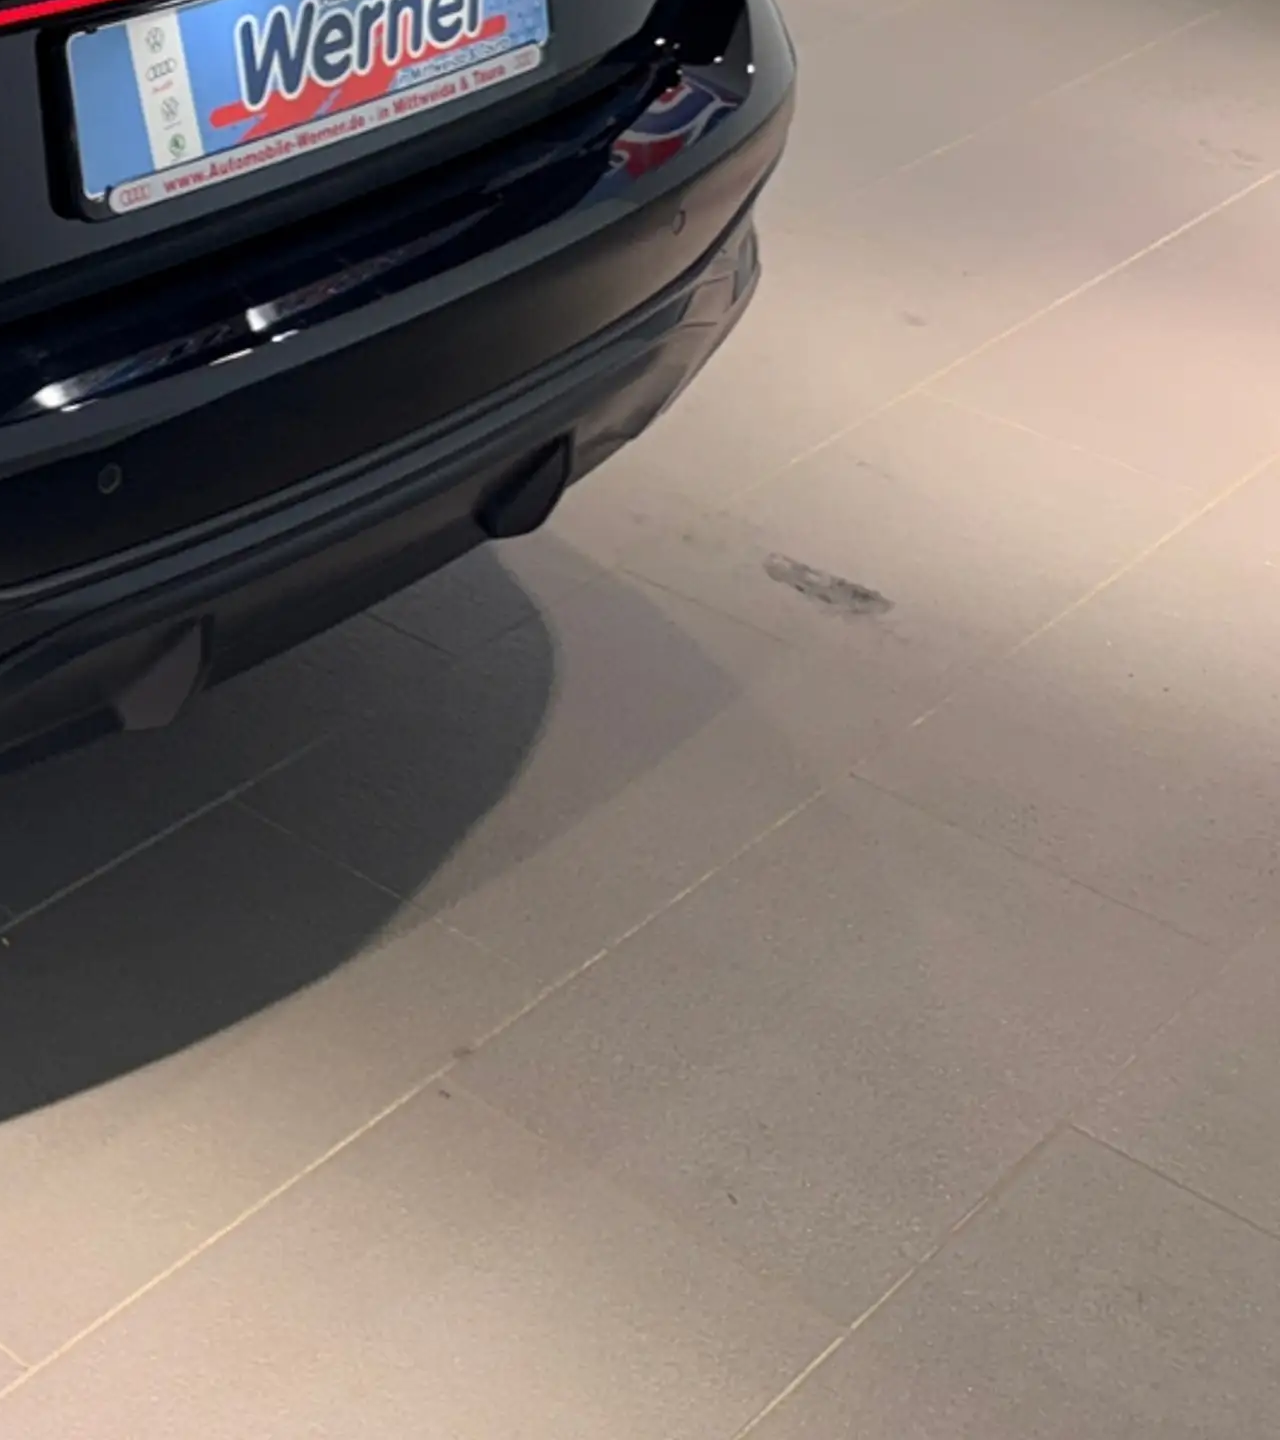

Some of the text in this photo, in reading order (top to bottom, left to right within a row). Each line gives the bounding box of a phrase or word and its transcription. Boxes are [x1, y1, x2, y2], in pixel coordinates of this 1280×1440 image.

[163, 114, 366, 193] www.Automobile-Werner.de
[392, 81, 456, 114] Mittweida
[472, 64, 506, 84] Taura
